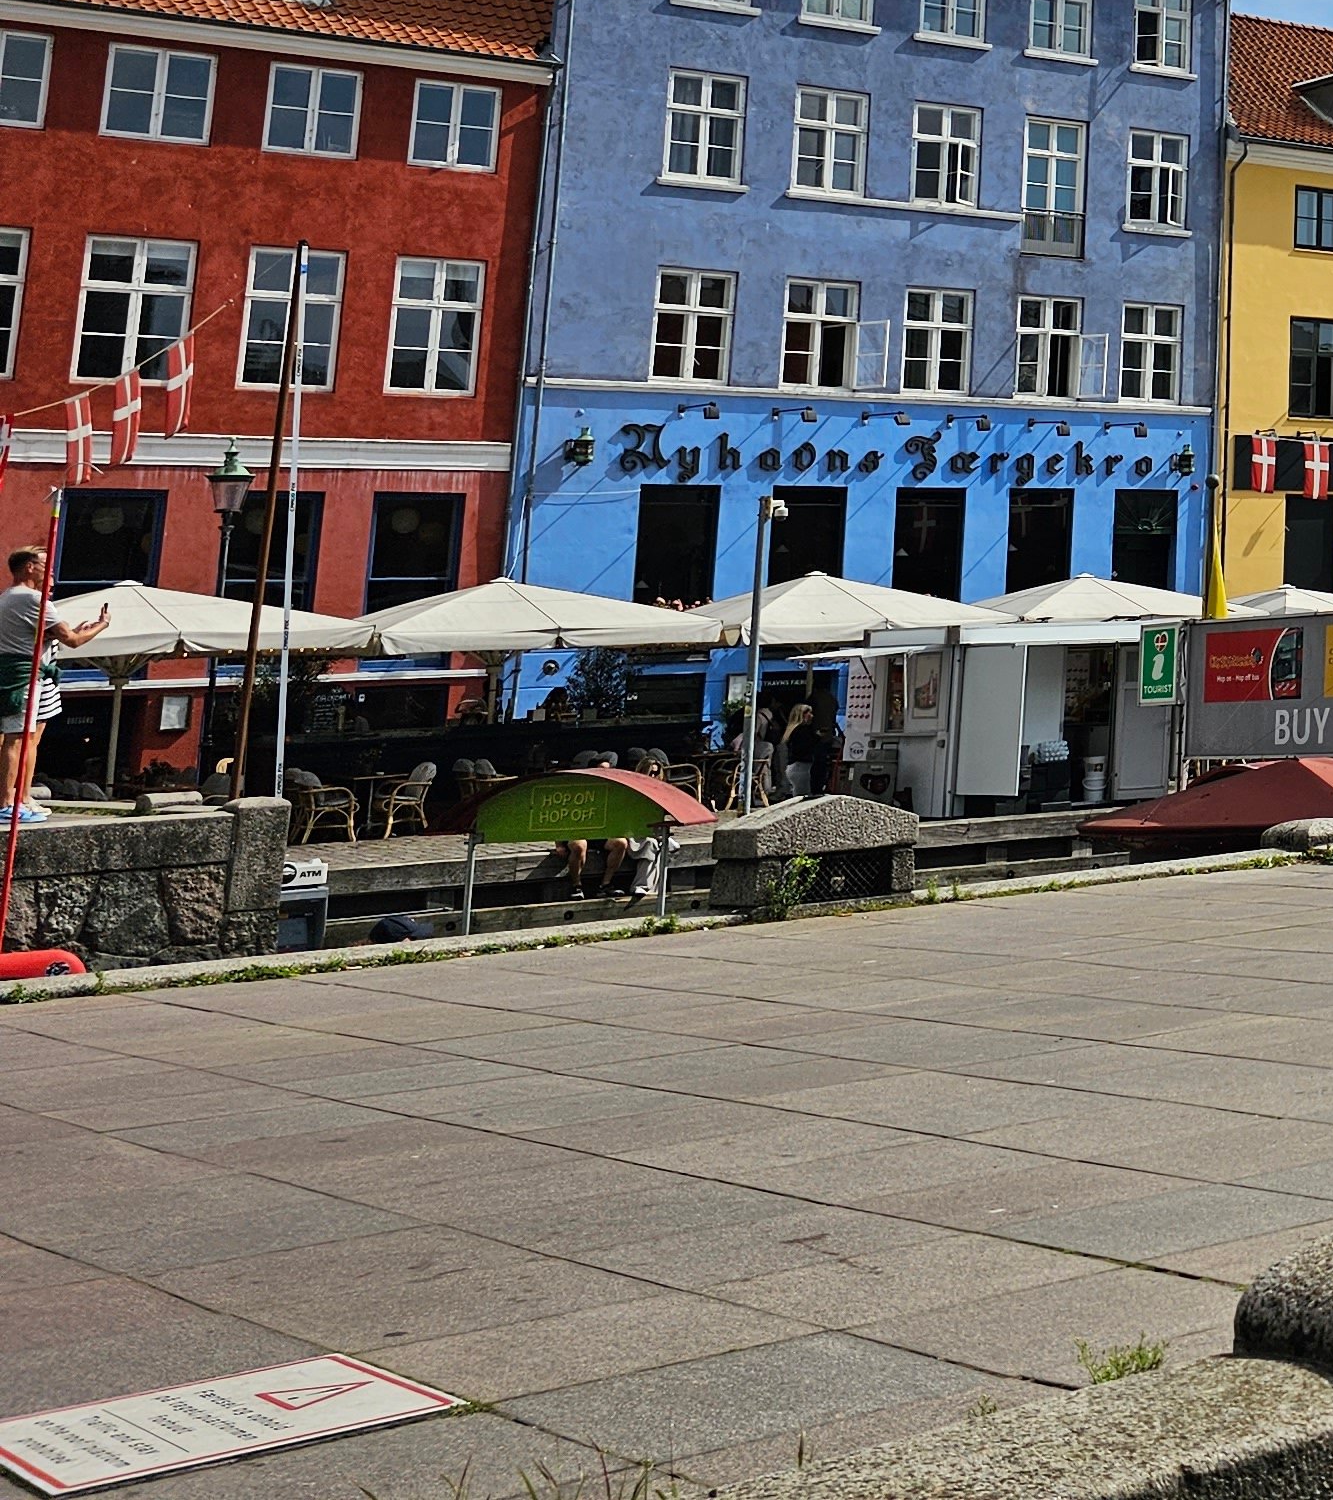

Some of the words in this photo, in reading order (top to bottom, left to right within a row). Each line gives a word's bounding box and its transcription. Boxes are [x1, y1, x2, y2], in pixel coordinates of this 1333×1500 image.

[620, 423, 885, 483] Nyhavns
[905, 430, 1153, 487] Færgekro
[1144, 684, 1172, 694] TOURIST
[1274, 708, 1329, 745] BUY
[542, 792, 571, 807] HOP
[574, 790, 595, 805] ON
[540, 809, 569, 823] HOP
[571, 807, 597, 822] OFF
[300, 870, 321, 878] ATM
